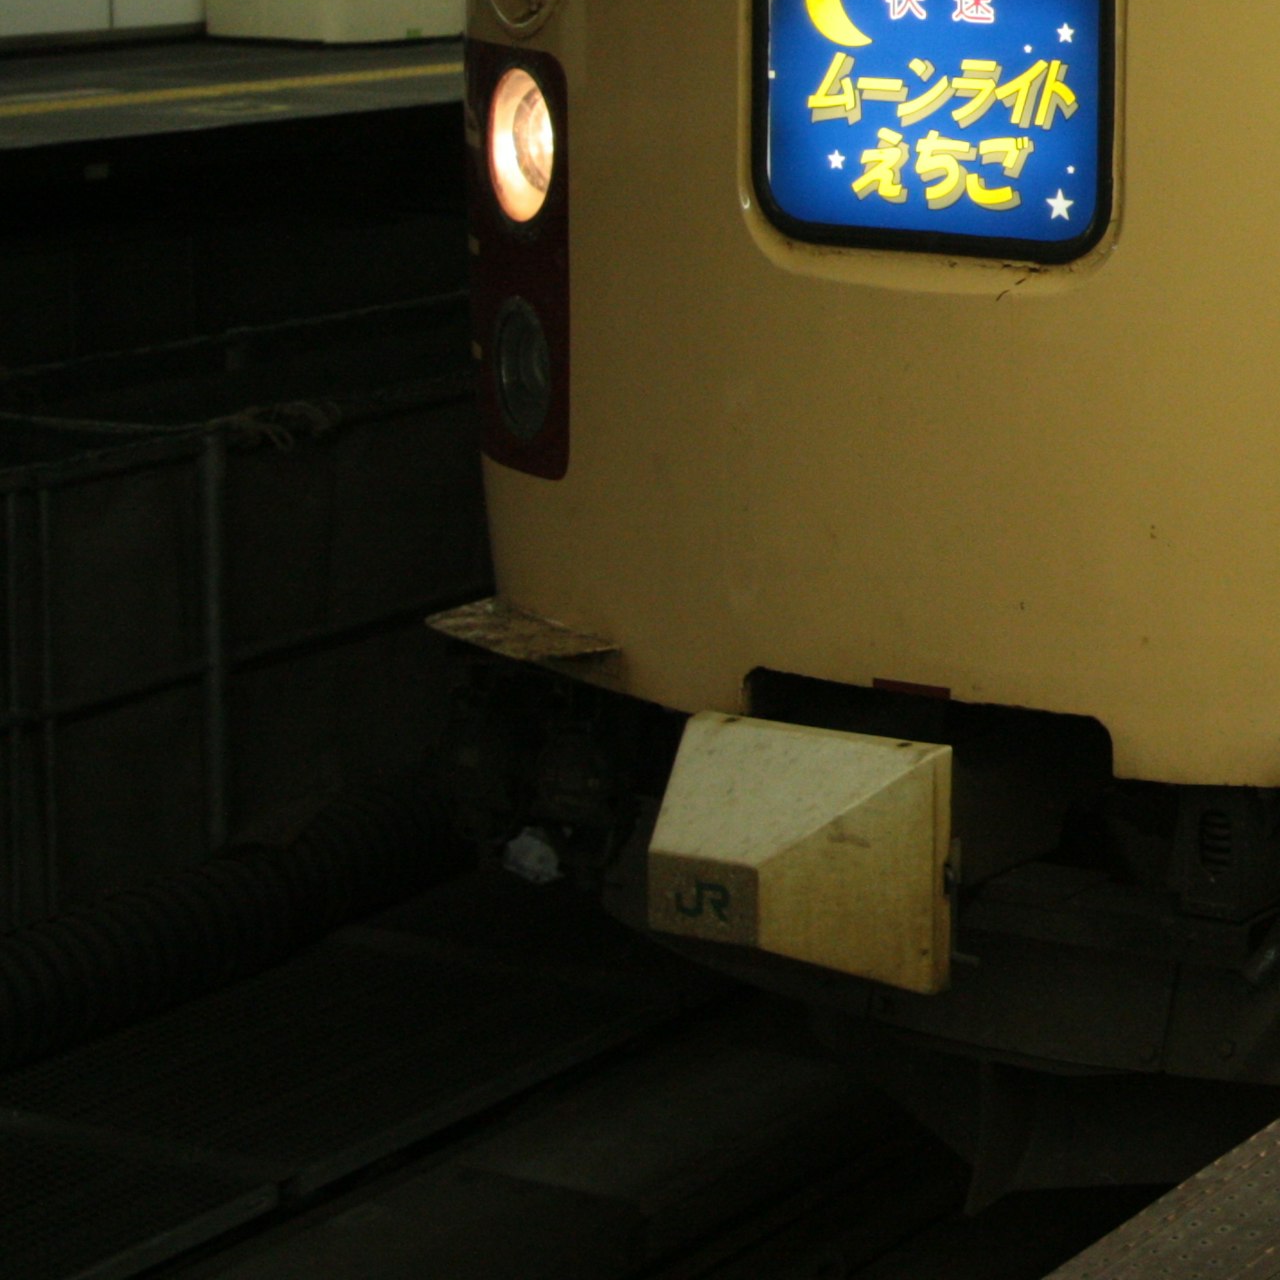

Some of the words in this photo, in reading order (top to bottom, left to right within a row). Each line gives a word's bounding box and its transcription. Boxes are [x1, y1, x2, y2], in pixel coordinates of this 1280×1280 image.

[807, 51, 1079, 130] ムーンライト
[851, 127, 1035, 211] えちご
[675, 880, 728, 921] JR
